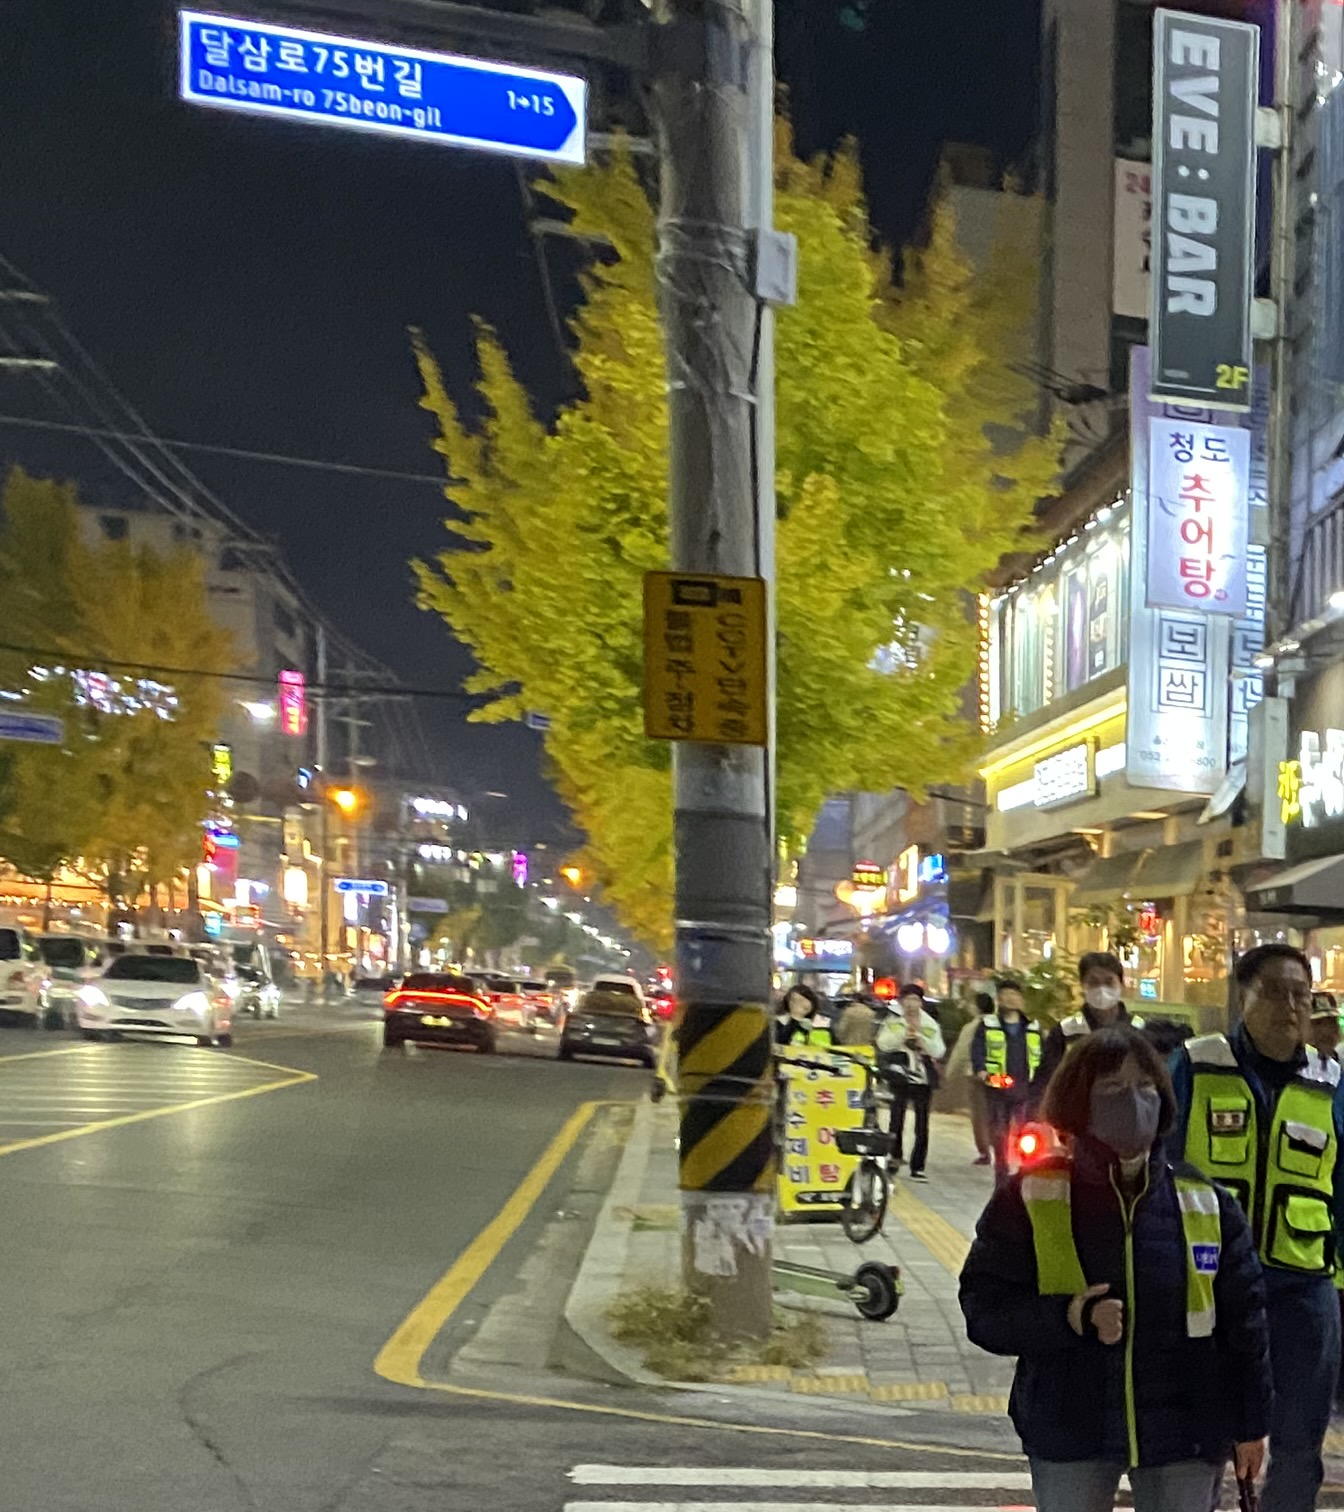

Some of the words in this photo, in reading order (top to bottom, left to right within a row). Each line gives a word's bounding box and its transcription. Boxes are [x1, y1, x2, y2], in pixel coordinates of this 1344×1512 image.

[200, 28, 423, 99] 달삼로75번길
[199, 69, 316, 107] Dalsam-ro
[323, 90, 442, 128] 75beon-gil
[1215, 363, 1250, 391] 2F
[1169, 432, 1230, 464] 청도
[1178, 473, 1217, 600] 추어탕
[1165, 624, 1200, 704] 보쌈
